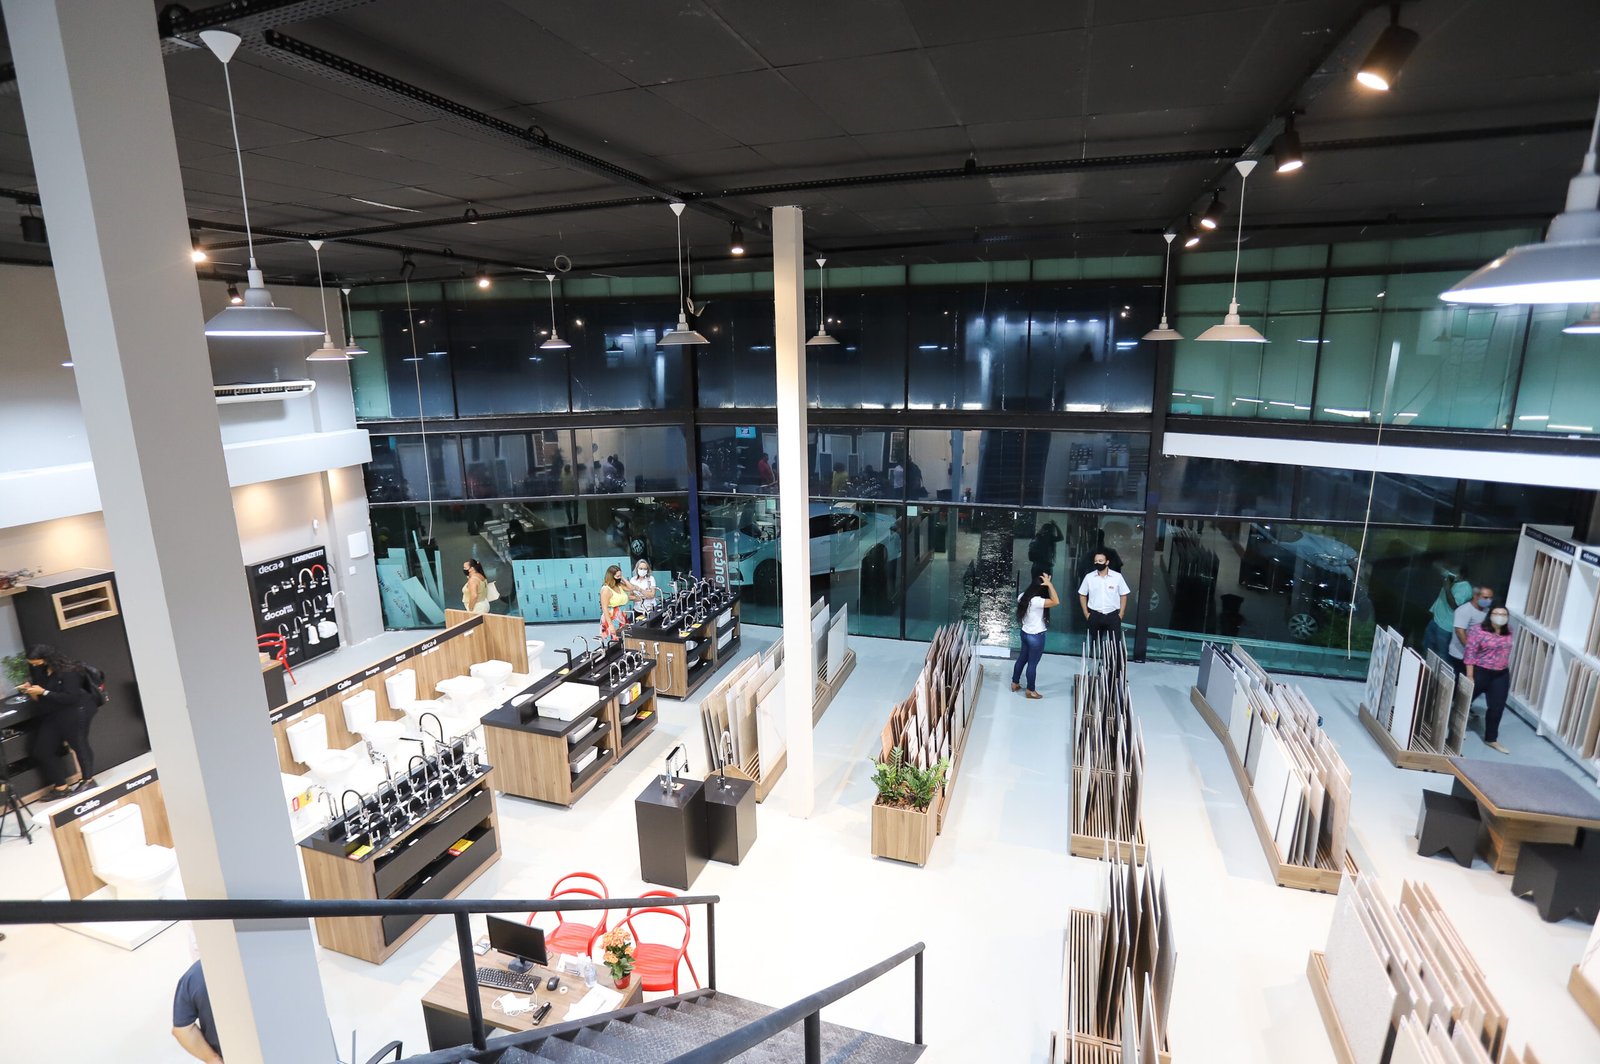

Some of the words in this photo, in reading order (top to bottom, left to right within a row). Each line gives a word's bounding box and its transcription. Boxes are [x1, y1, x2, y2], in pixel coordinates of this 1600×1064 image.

[292, 549, 324, 564] LORENZETTI
[258, 562, 278, 575] deca
[713, 541, 726, 588] ouças
[264, 605, 286, 621] docol
[126, 775, 152, 790] Incepa
[74, 799, 100, 815] Celite
